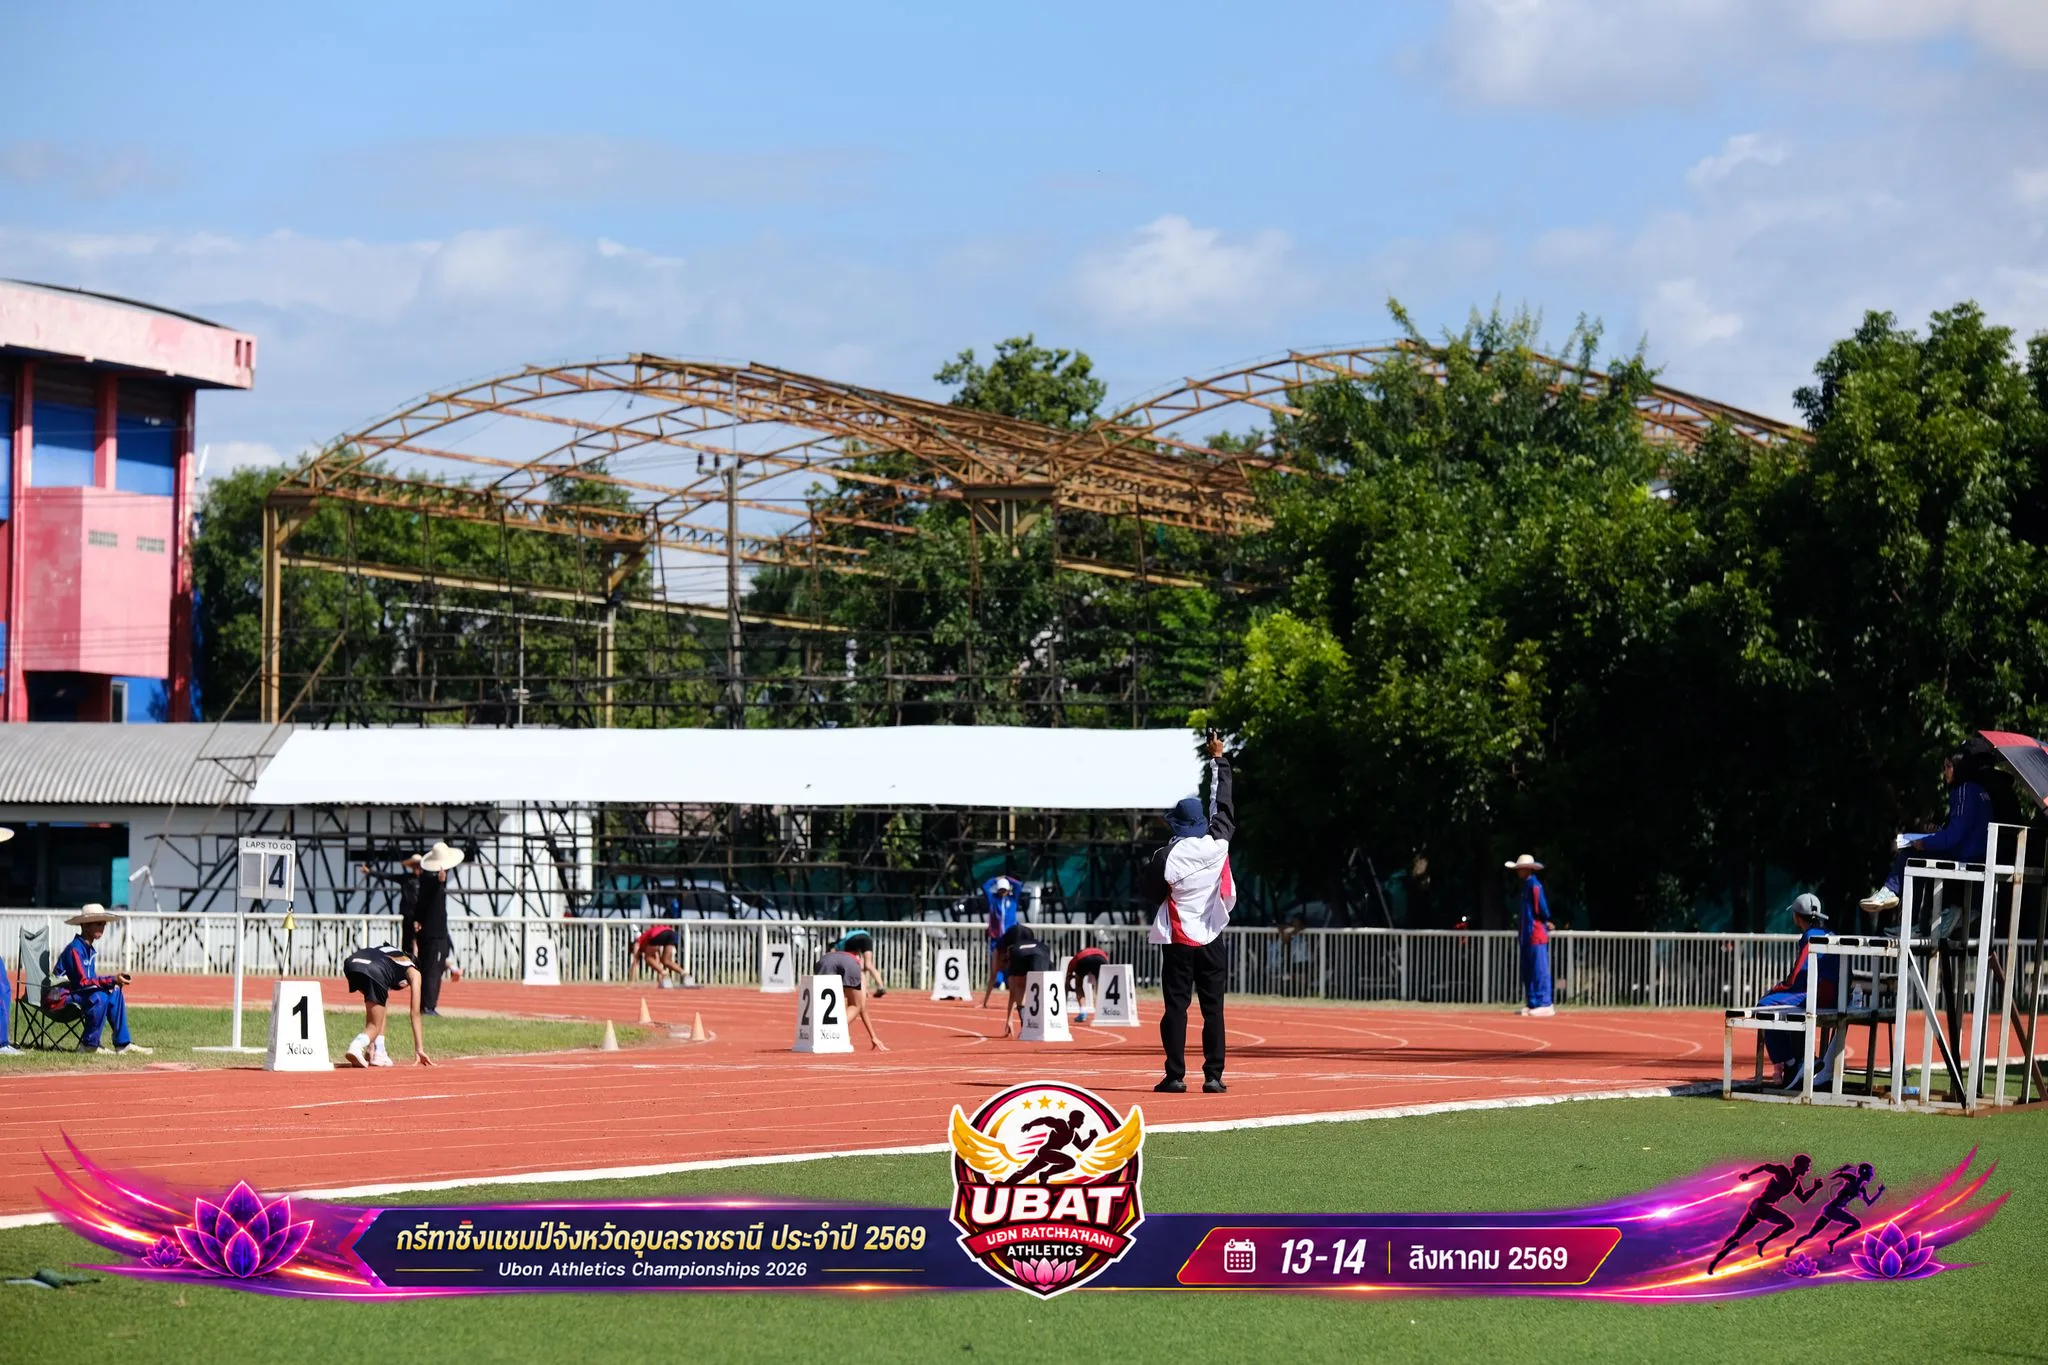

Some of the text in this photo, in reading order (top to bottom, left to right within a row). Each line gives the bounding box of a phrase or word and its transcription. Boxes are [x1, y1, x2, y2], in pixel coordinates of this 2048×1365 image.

[245, 841, 292, 850] LAPS TO GO
[268, 855, 285, 888] 4
[535, 946, 548, 967] 8
[771, 951, 785, 975] 7
[944, 956, 959, 981] 6
[820, 987, 838, 1025] 2
[1029, 982, 1040, 1016] 3
[1049, 983, 1060, 1016] 3
[1104, 974, 1121, 1005] 4
[292, 995, 309, 1040] 1
[801, 988, 811, 1025] 2
